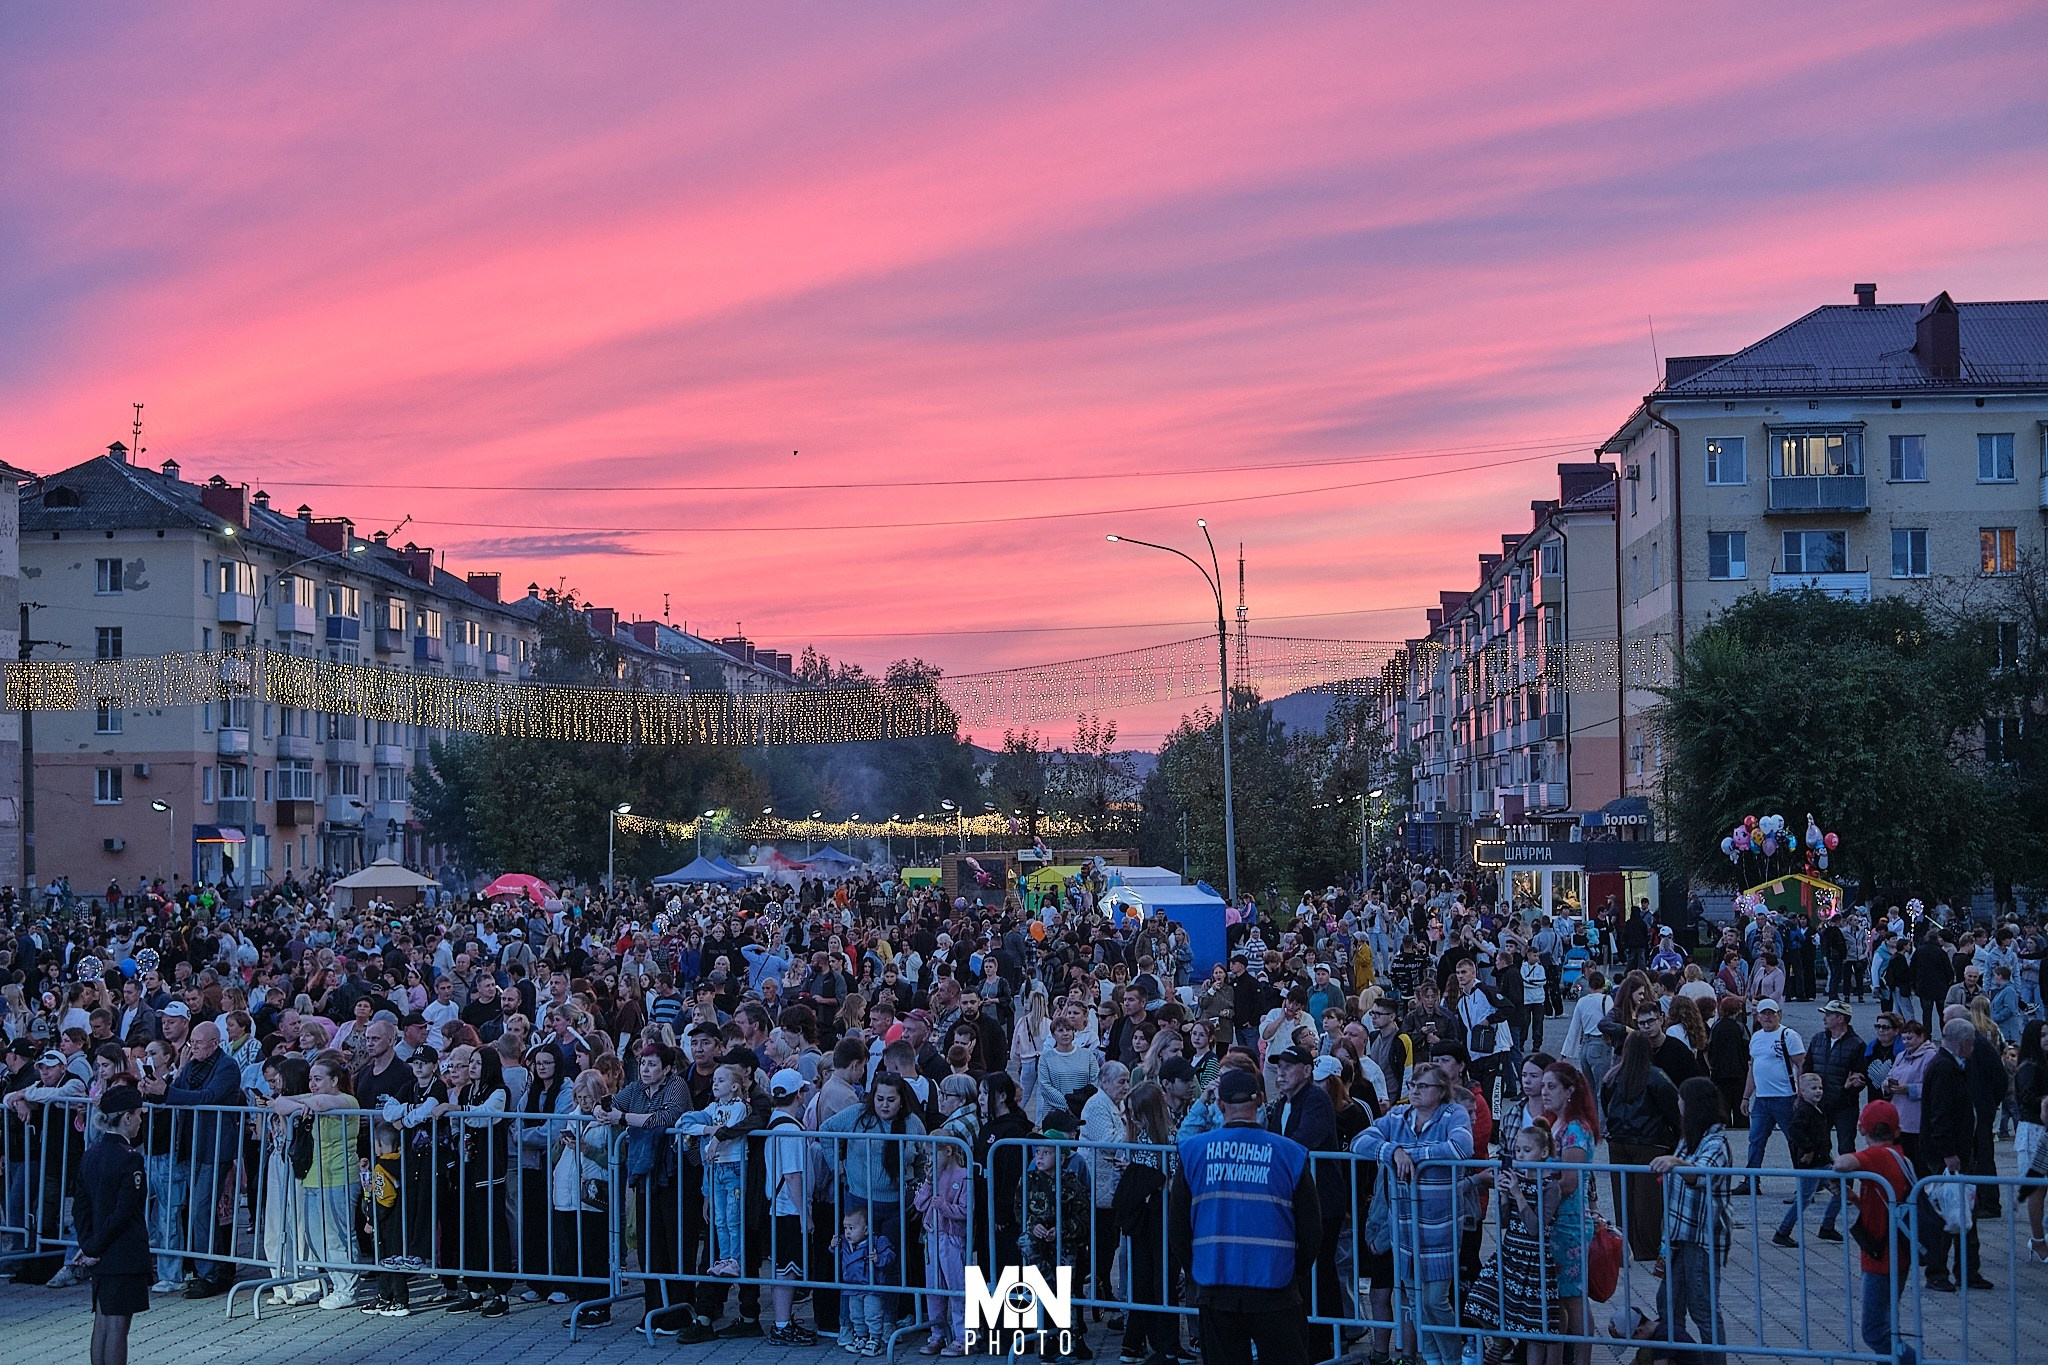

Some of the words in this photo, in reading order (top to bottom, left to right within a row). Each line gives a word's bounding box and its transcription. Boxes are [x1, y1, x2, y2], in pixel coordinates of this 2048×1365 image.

[1605, 813, 1648, 825] болов
[1504, 845, 1552, 860] ШАУРМА
[1206, 1141, 1273, 1163] НАРОДНЫЙ
[1206, 1163, 1271, 1185] ДРУЖИННИК
